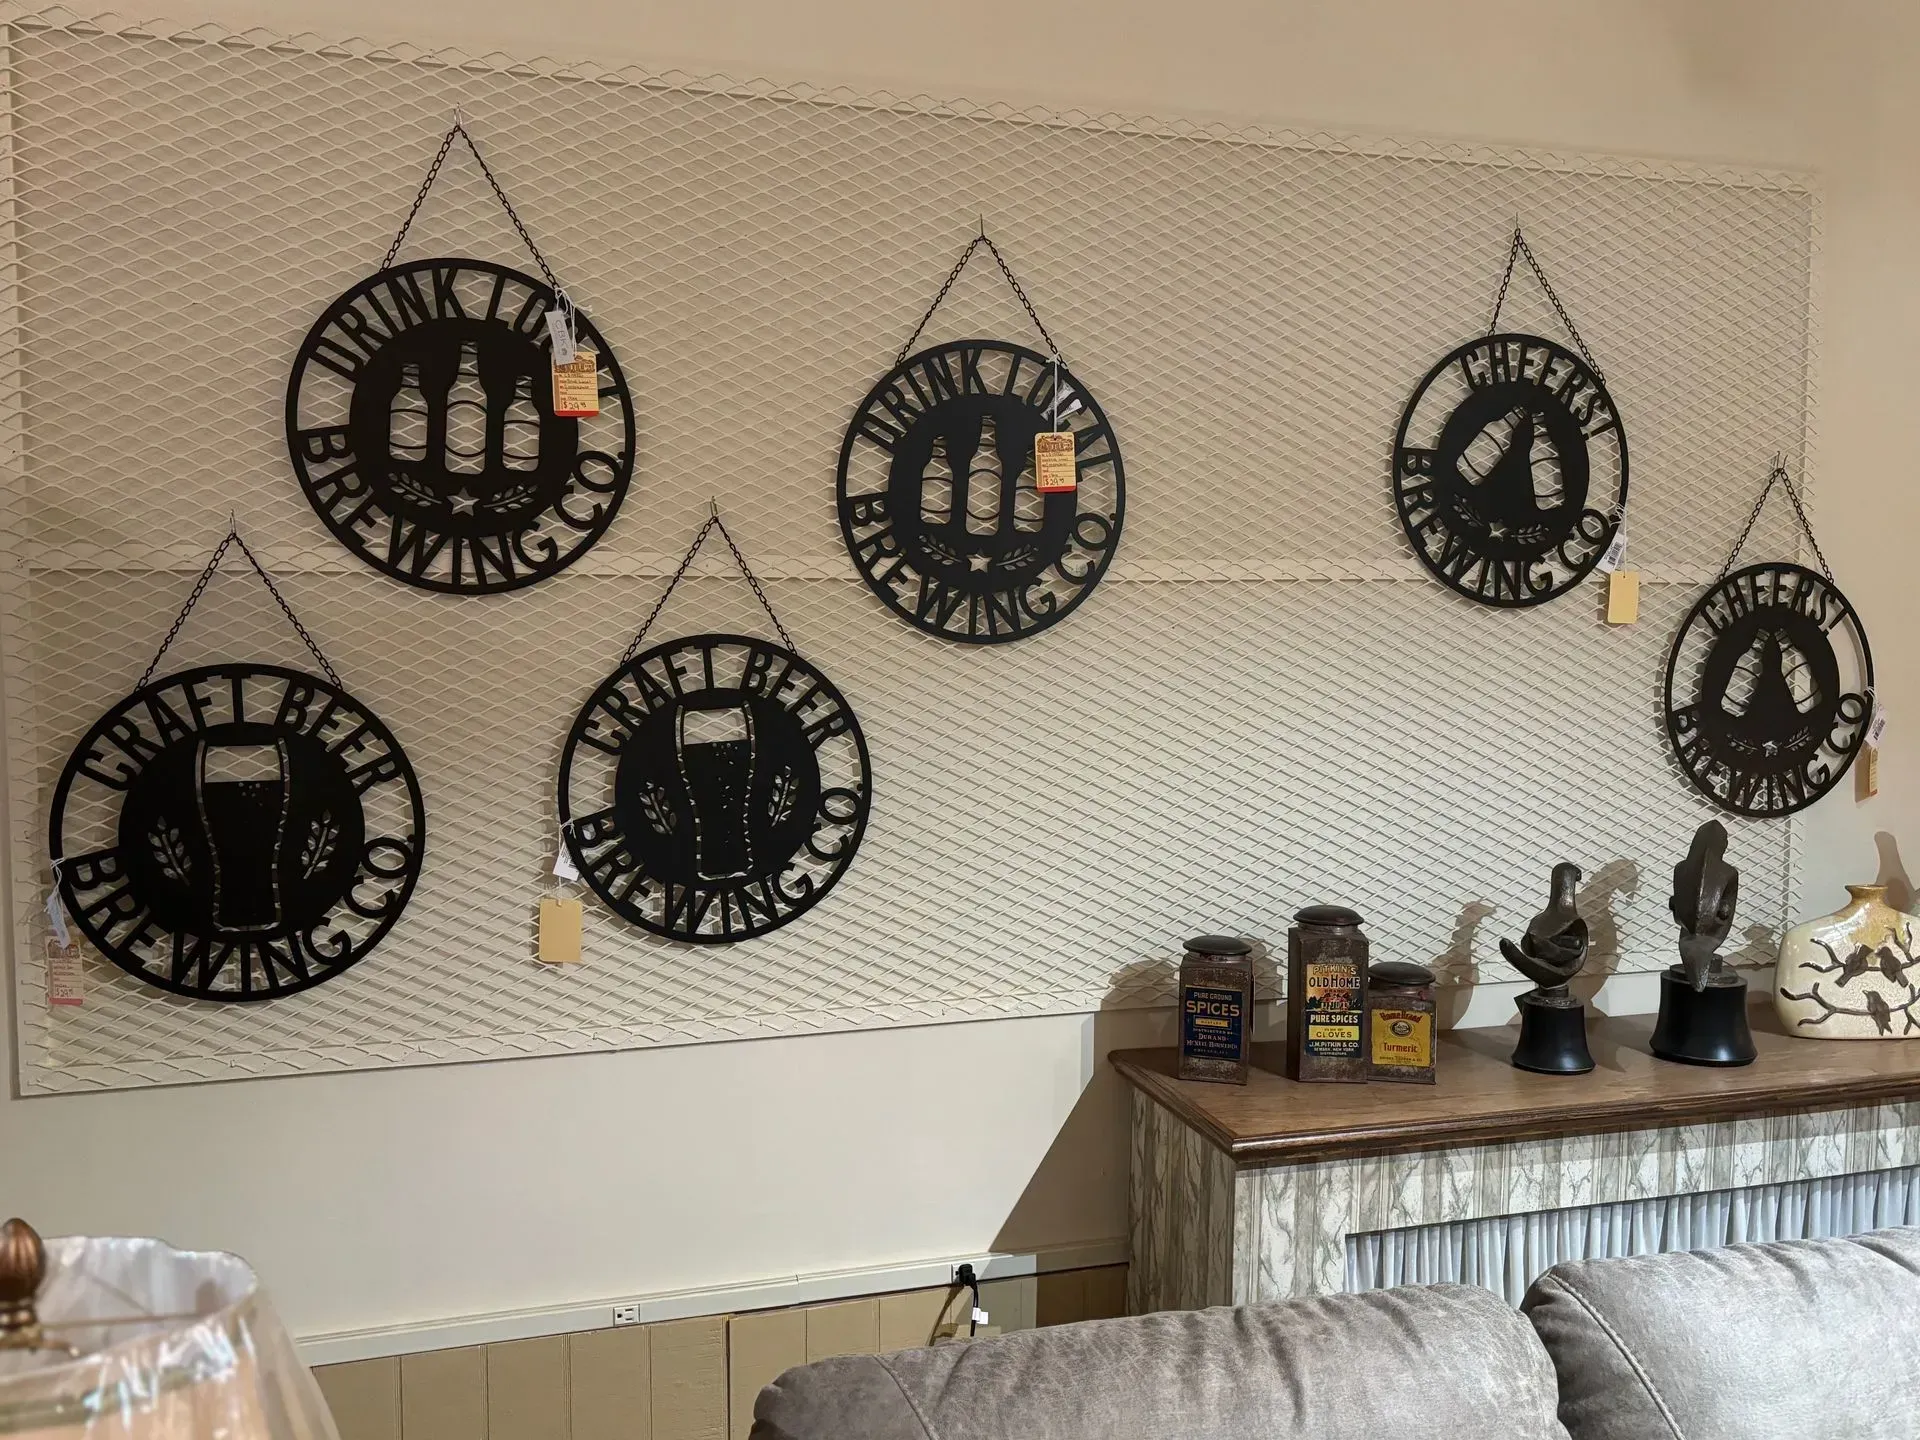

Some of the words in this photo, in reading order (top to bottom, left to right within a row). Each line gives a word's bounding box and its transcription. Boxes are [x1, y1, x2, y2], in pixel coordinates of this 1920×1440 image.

[306, 266, 468, 383] DRINK
[853, 349, 988, 454] DRINK
[298, 424, 559, 586] BREWING
[1401, 448, 1553, 600] BREWING
[846, 492, 1056, 635] BREWING
[77, 674, 250, 792] CRAFT
[274, 678, 402, 797] BEER
[578, 646, 719, 756] CRAFT
[740, 648, 850, 752] BEER
[1672, 704, 1830, 810] BREWING
[64, 846, 352, 993] BREWING
[570, 806, 814, 934] BREWING
[1186, 1000, 1240, 1017] SPICES
[1308, 976, 1330, 988] OLD
[1330, 974, 1360, 988] HOME
[1310, 1014, 1330, 1023] PURE
[1331, 1014, 1359, 1024] SPICES
[1313, 965, 1358, 975] PITKIN'S
[1384, 1042, 1418, 1052] Turmeric
